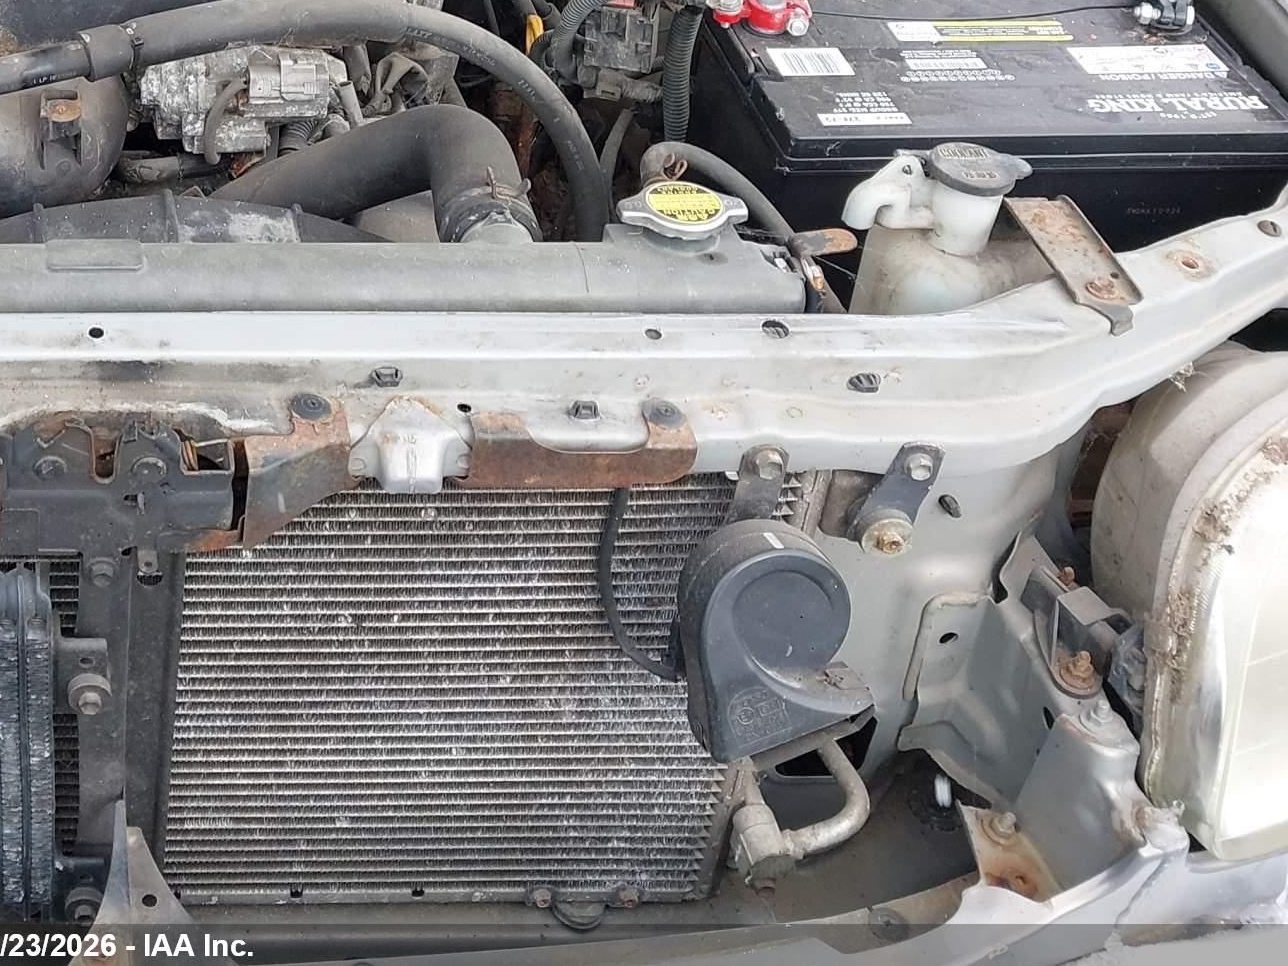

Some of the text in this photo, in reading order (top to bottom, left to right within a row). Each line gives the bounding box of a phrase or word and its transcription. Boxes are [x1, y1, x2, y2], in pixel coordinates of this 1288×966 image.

[1098, 72, 1152, 81] POISON
[1157, 71, 1216, 81] DANGER
[1087, 95, 1268, 113] RURAL KING
